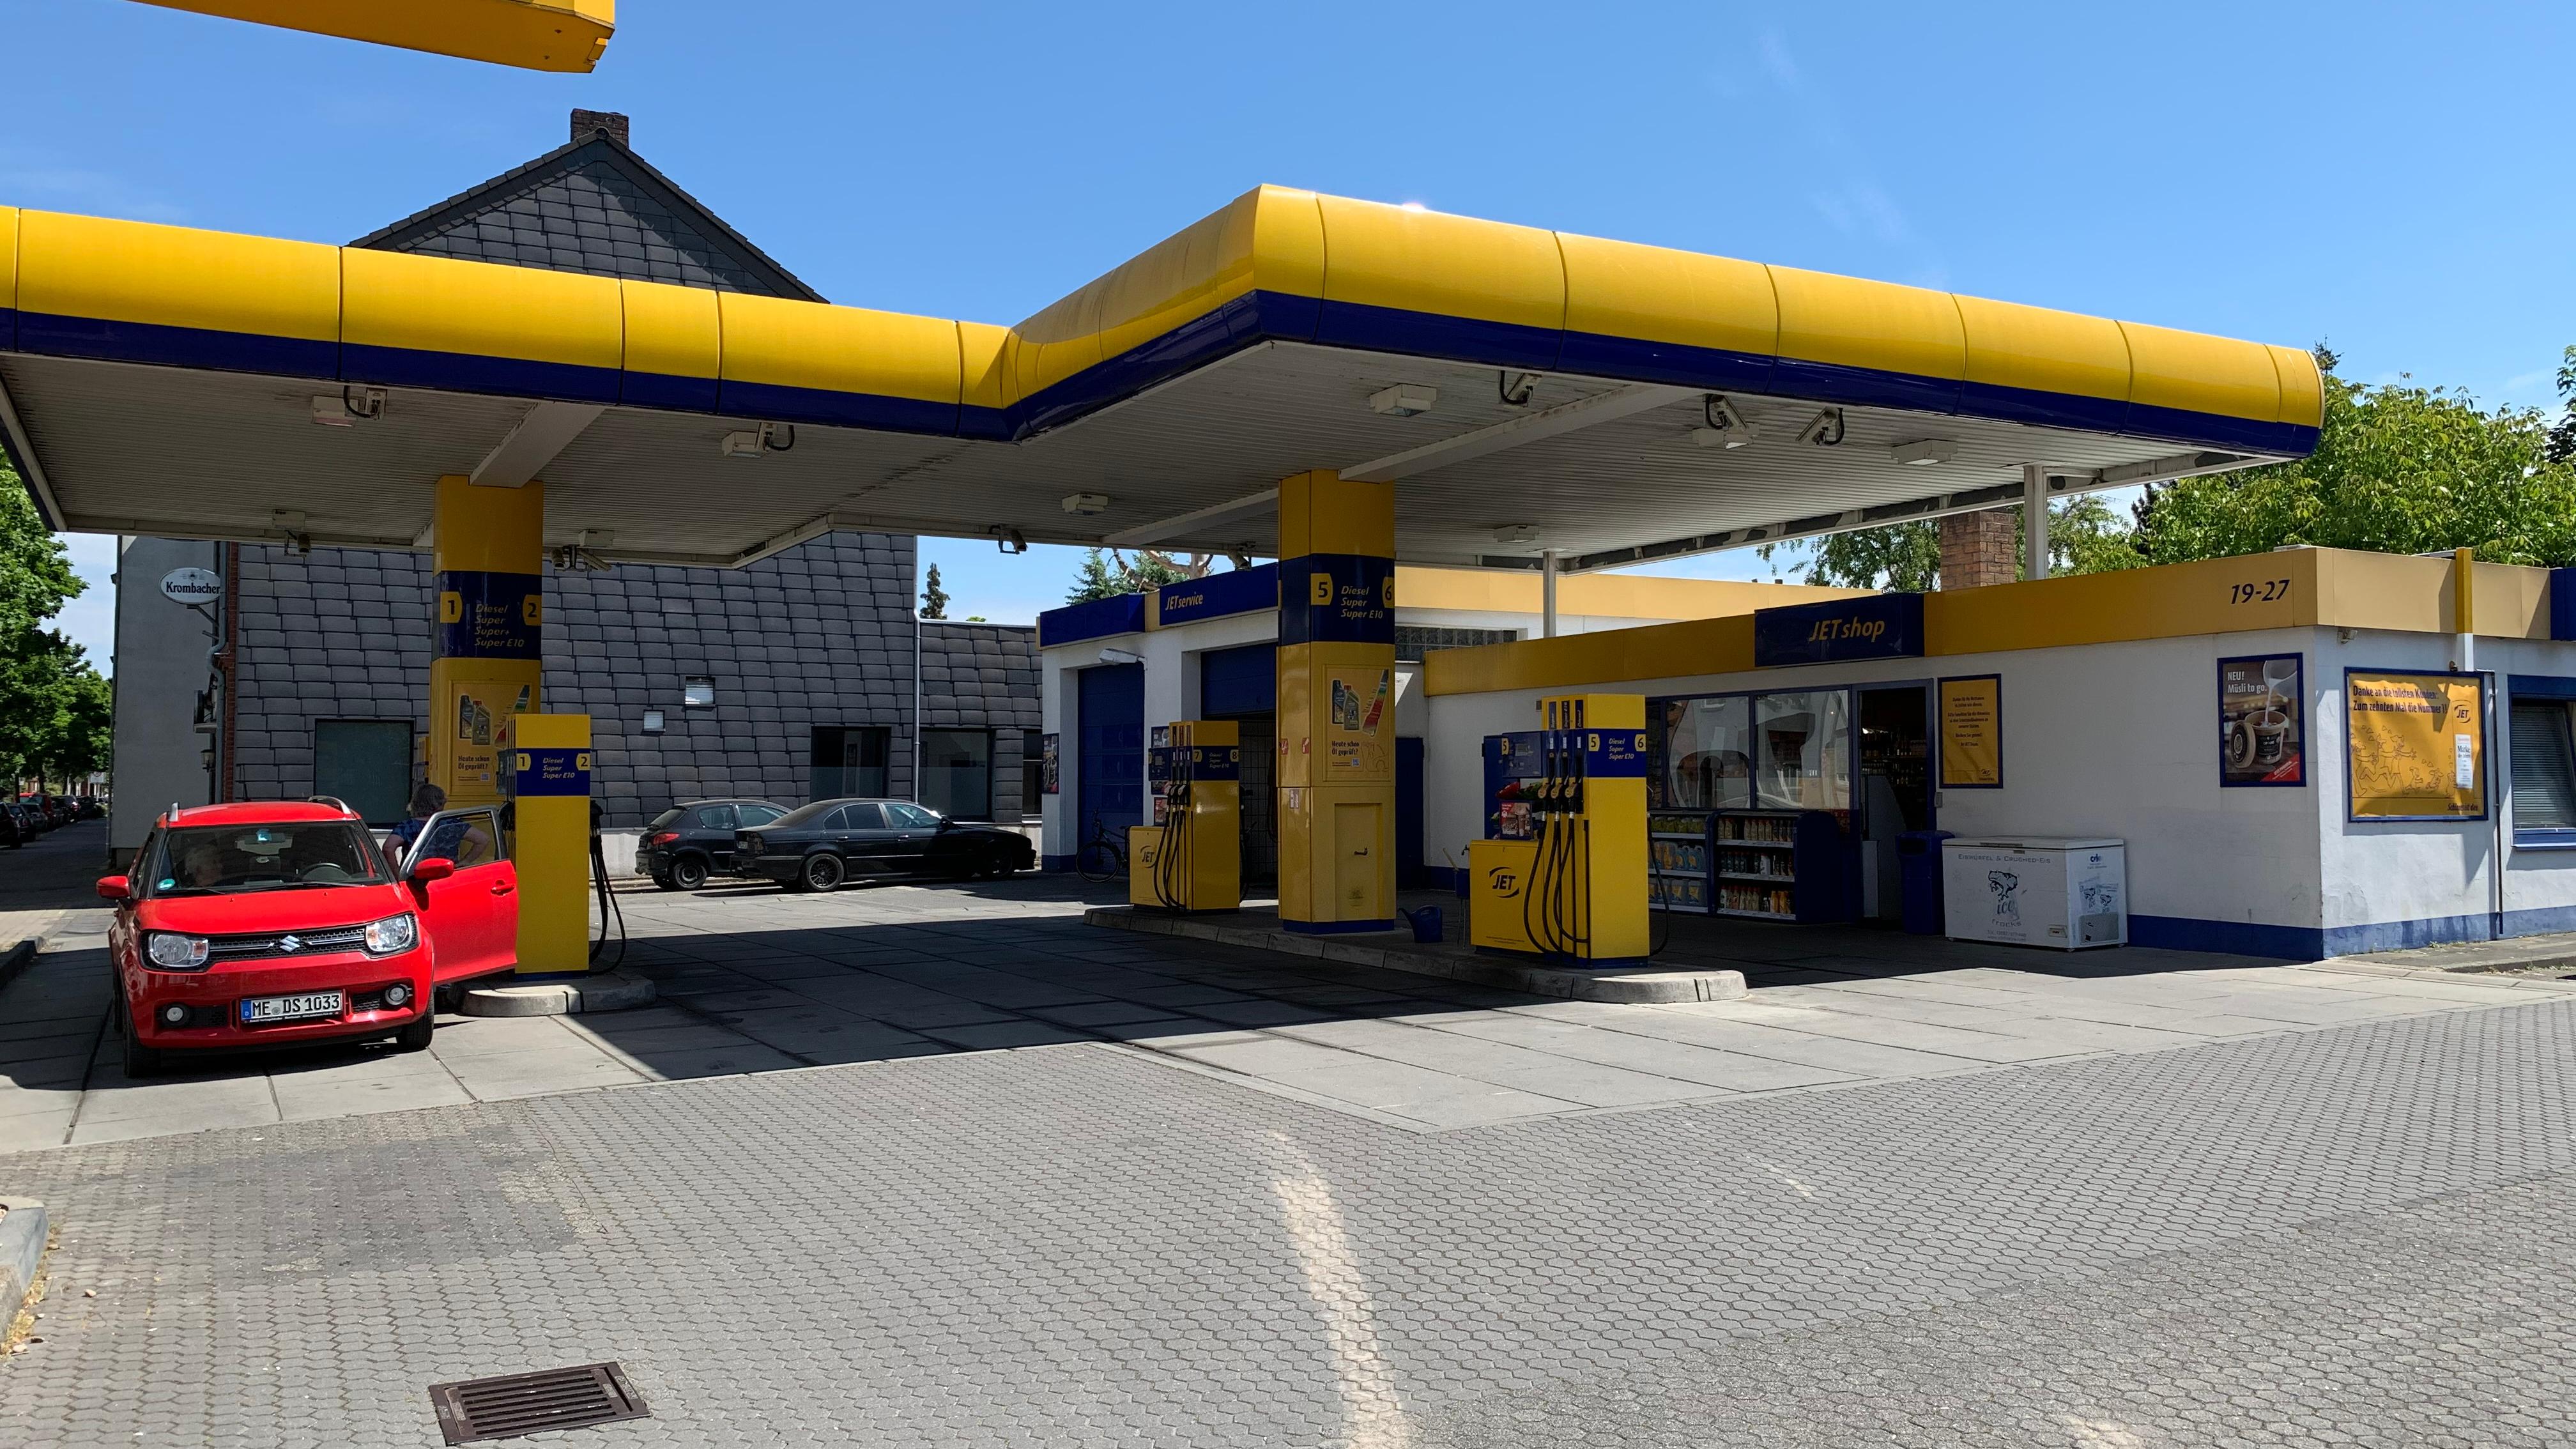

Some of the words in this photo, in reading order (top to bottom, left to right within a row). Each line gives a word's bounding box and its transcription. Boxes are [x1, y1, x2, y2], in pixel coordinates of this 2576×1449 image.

[166, 582, 220, 594] Krombacher
[1318, 581, 1328, 598] 5
[1341, 585, 1370, 595] Diesel
[1385, 585, 1392, 601] 6
[2231, 579, 2290, 604] 19-27
[1165, 595, 1179, 611] JET
[1178, 591, 1204, 608] service
[1340, 597, 1367, 608] Super
[448, 599, 455, 615] 1
[476, 603, 508, 613] Diesel
[527, 602, 537, 618] 2
[1340, 609, 1367, 620] Super
[1369, 610, 1383, 619] E10
[475, 615, 506, 626] Super
[475, 626, 510, 638] Super+
[1809, 619, 1843, 642] JET
[1840, 616, 1885, 643] shop
[475, 638, 505, 648] Super
[507, 639, 525, 647] E10
[2227, 671, 2244, 681] NEU!
[2227, 684, 2246, 693] Müsli
[2248, 684, 2255, 692] to
[2257, 685, 2267, 694] go.
[2353, 685, 2373, 697] Danke
[2375, 689, 2382, 697] an
[2384, 687, 2392, 697] die
[2393, 687, 2414, 698] tollsten
[2353, 700, 2368, 712] Zum
[2370, 700, 2394, 712] zehnten
[2395, 702, 2406, 712] Mal
[2408, 702, 2417, 712] die
[2418, 703, 2441, 713] Nummer
[2457, 709, 2469, 718] JET
[1503, 741, 1507, 750] 5
[1591, 737, 1597, 748] 5
[1637, 737, 1644, 748] 6
[520, 756, 525, 767] 1
[581, 756, 588, 767] 2
[1142, 851, 1154, 862] JET
[1492, 875, 1516, 890] JET
[253, 1001, 270, 1016] ME
[283, 998, 300, 1013] DS
[305, 995, 339, 1011] 1033
